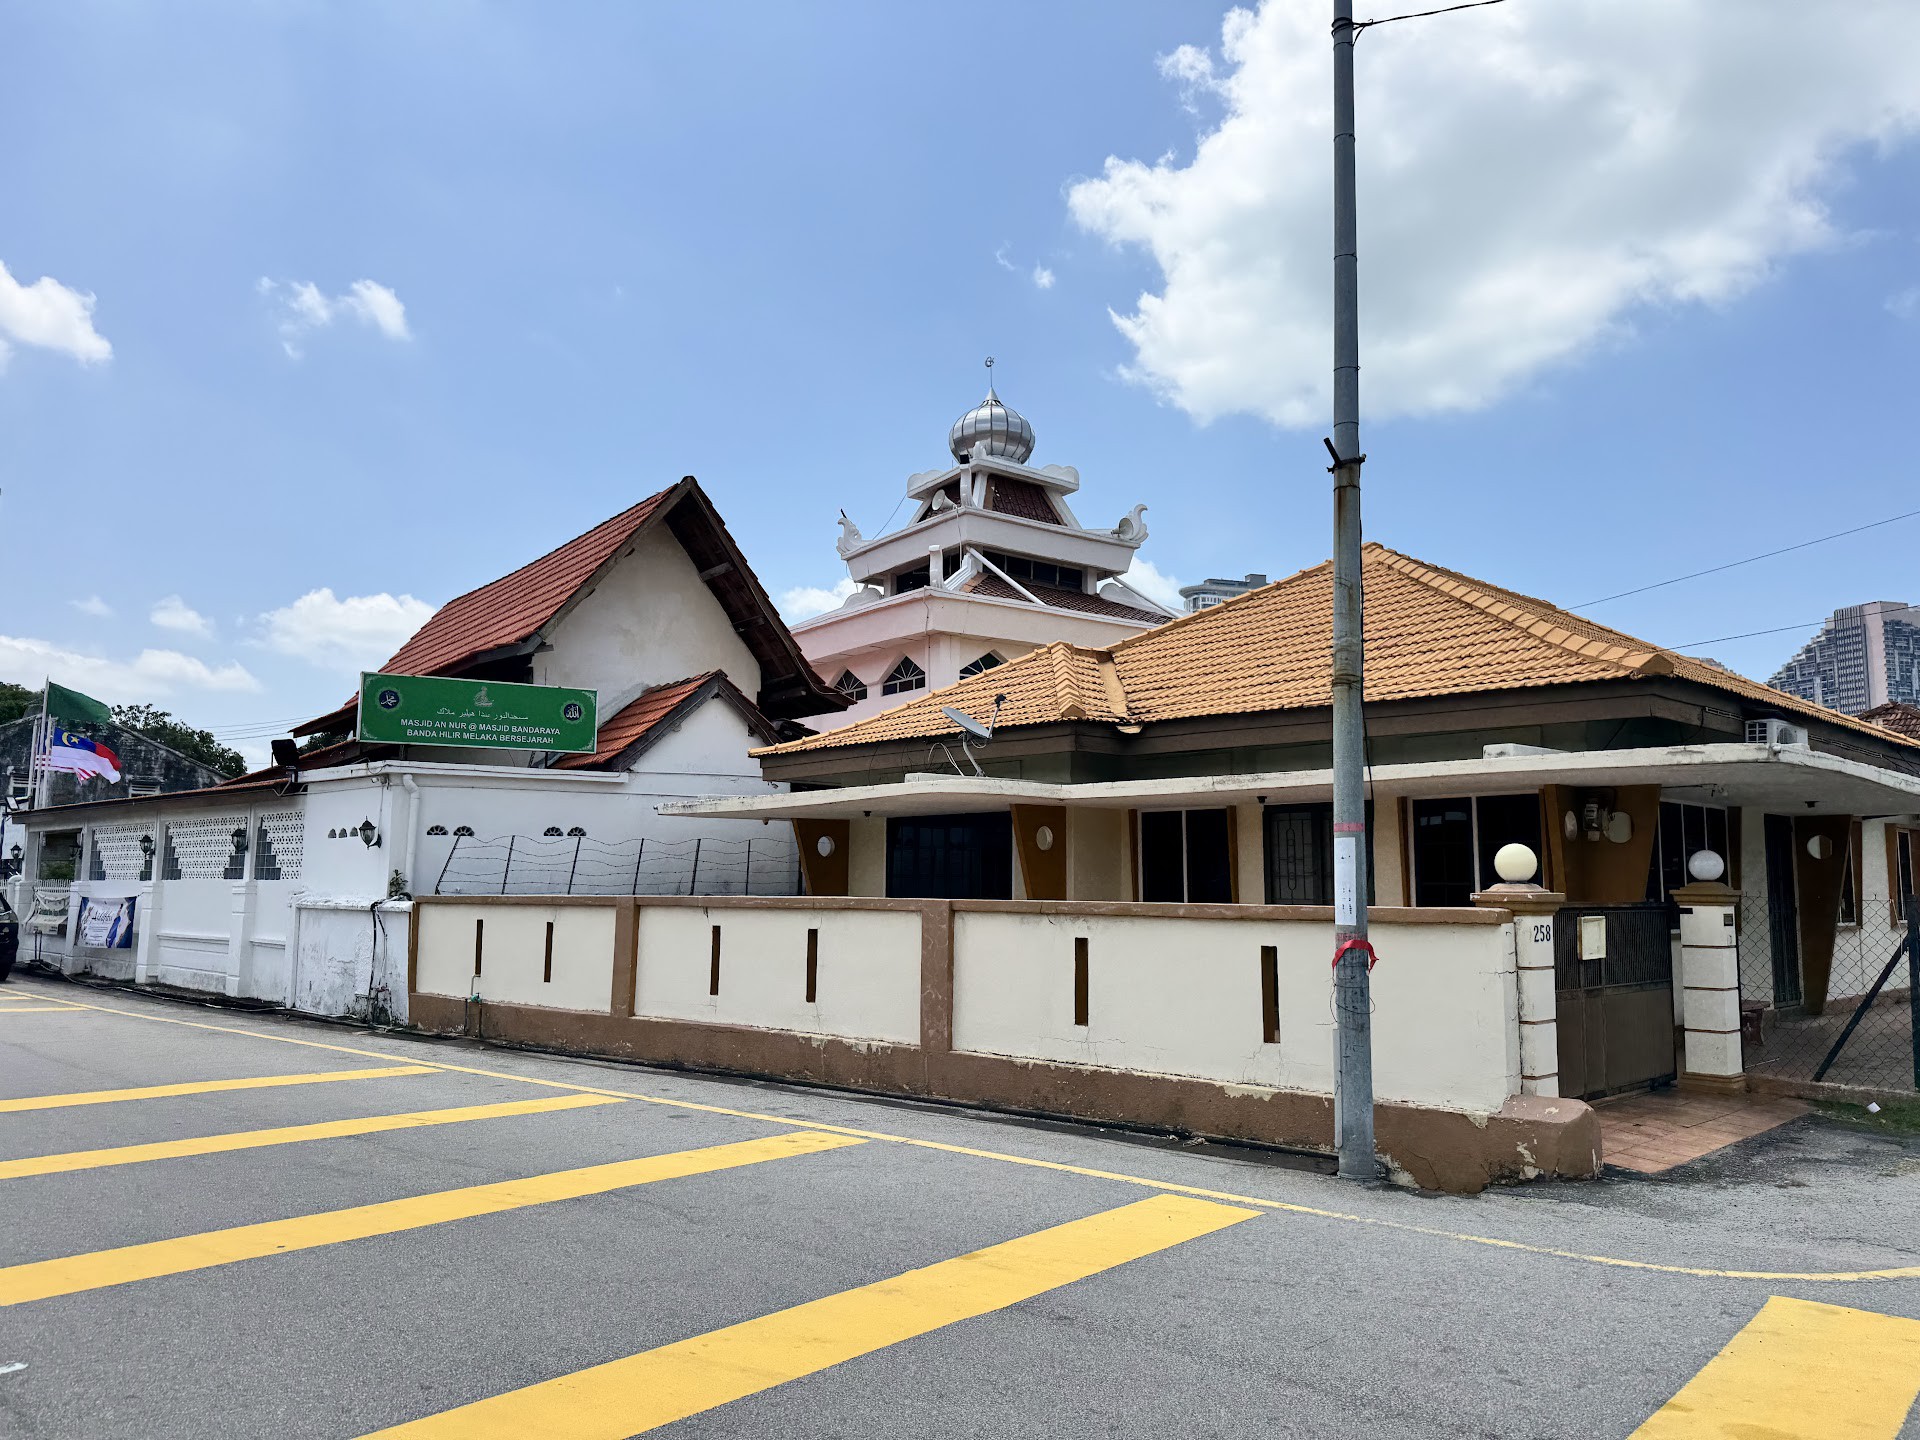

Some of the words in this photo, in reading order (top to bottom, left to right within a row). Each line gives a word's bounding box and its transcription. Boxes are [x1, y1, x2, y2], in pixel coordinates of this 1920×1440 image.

[400, 718, 433, 727] MASJID
[469, 723, 477, 731] @
[478, 723, 510, 732] MASJID
[511, 725, 561, 735] BANDARAYA
[406, 728, 438, 738] BANDA
[438, 730, 461, 739] HILIR
[462, 731, 498, 741] MELAKA
[499, 734, 554, 744] BERSEJARAH
[1533, 924, 1551, 943] 258
